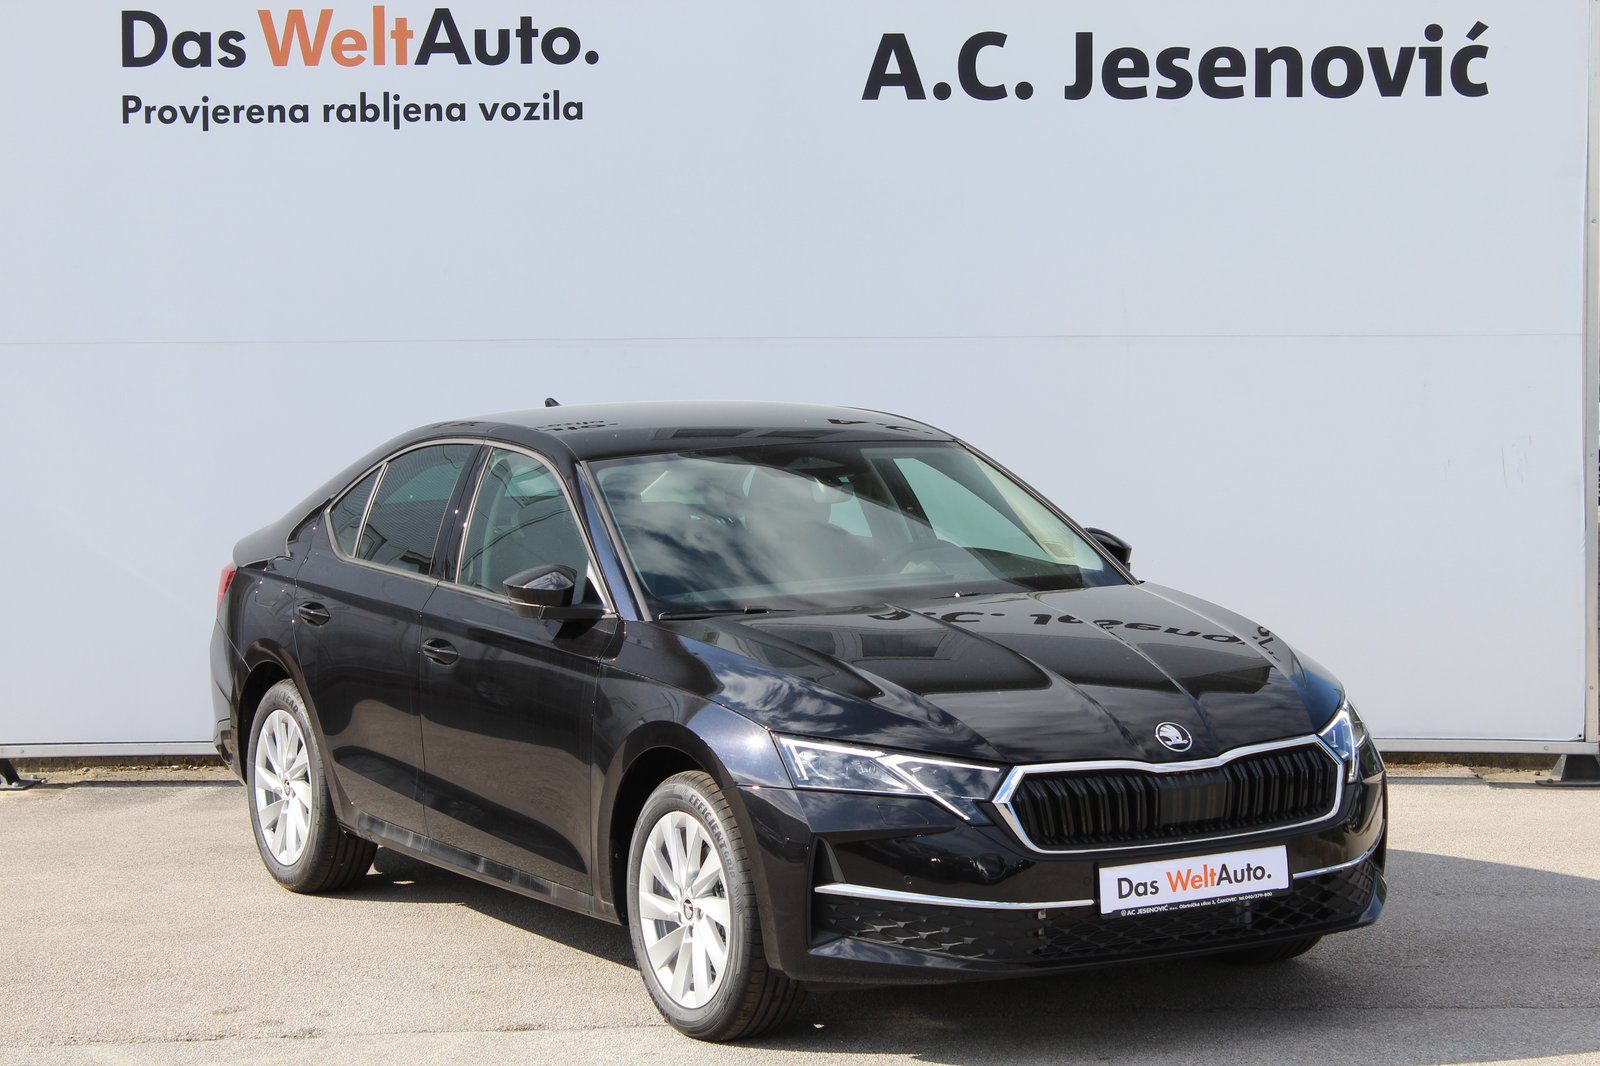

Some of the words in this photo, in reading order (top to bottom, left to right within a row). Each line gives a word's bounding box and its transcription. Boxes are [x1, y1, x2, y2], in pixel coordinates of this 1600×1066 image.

[121, 10, 247, 69] Das
[258, 6, 600, 68] WeltAuto.
[861, 30, 1034, 102] A.C.
[1064, 20, 1490, 101] Jesenović
[121, 94, 309, 132] Provjerena
[322, 91, 466, 131] rabljena
[478, 89, 584, 122] vozila
[1117, 877, 1159, 899] Das
[1165, 863, 1272, 893] WeltAuto.
[1136, 904, 1169, 915] JESENOVIĆ
